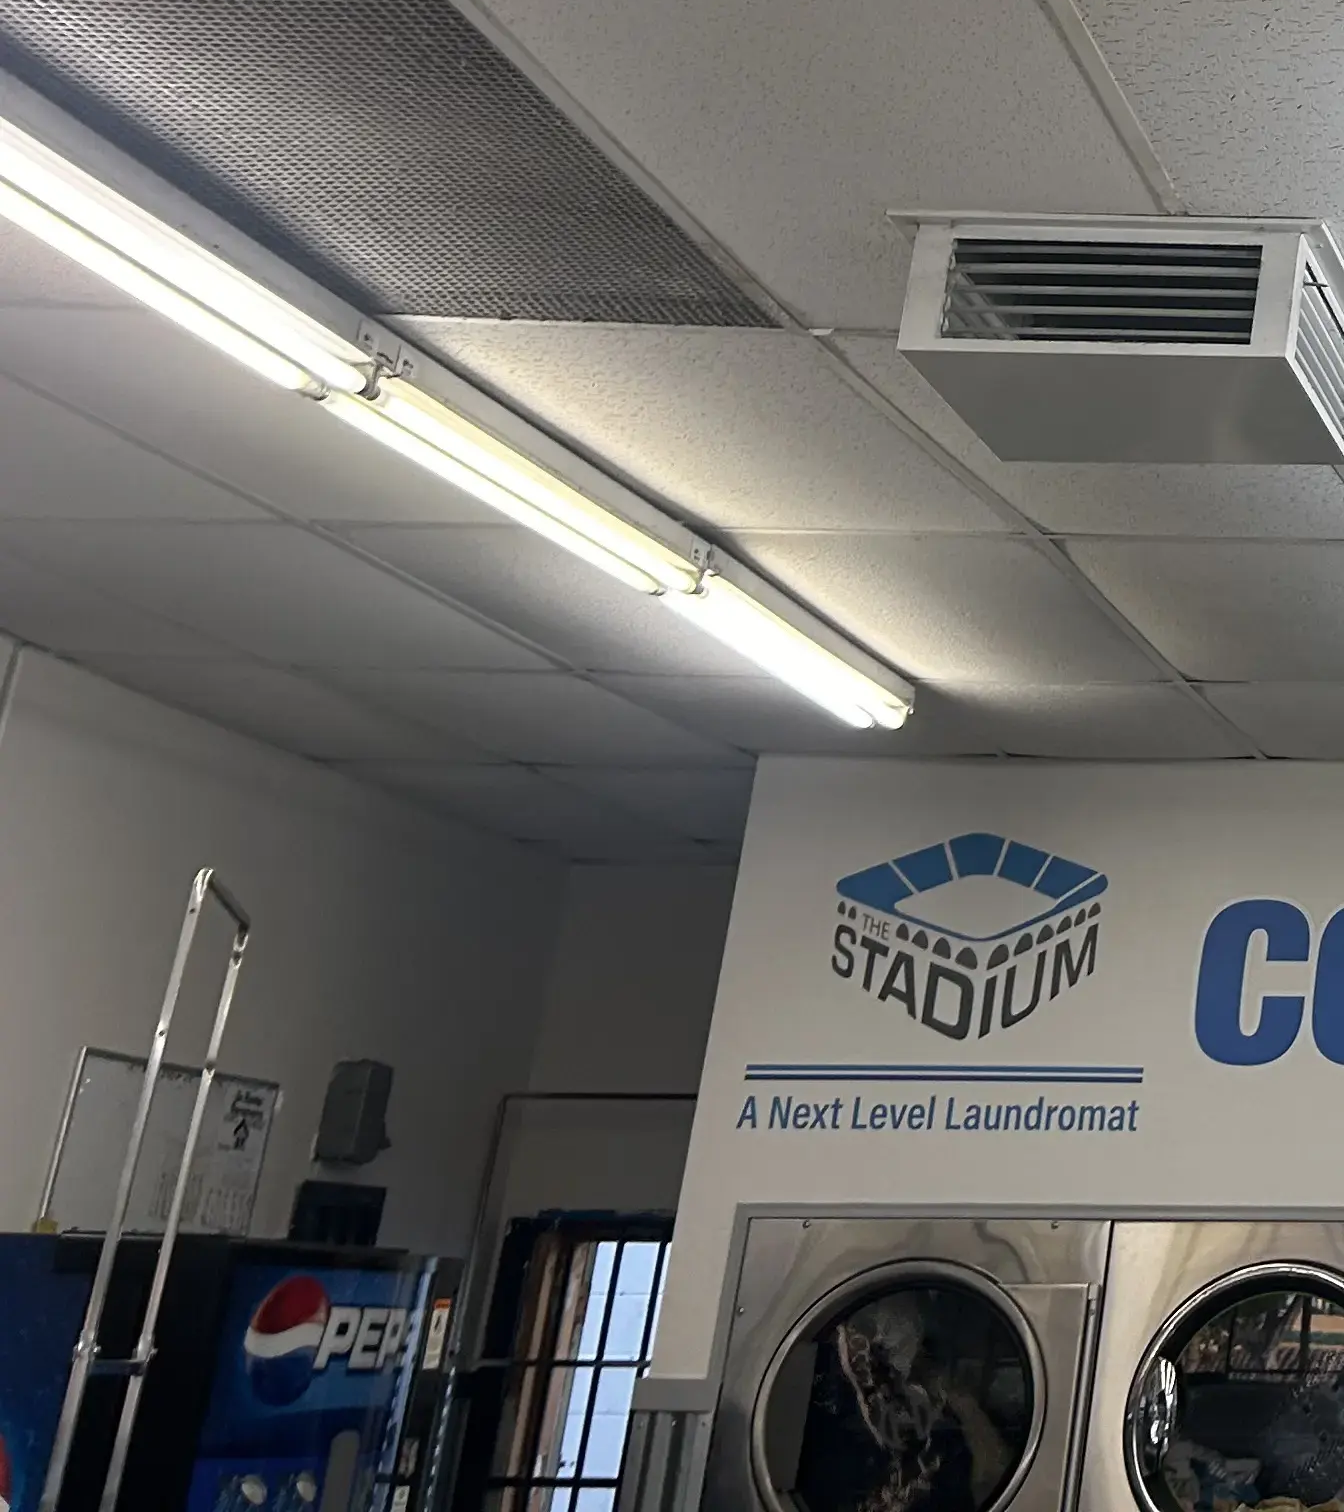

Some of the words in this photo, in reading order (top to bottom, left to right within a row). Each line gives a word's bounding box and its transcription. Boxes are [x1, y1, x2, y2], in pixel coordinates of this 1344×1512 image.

[862, 913, 890, 939] THE
[831, 923, 1099, 1041] STADIUM
[736, 1095, 757, 1130] A
[768, 1095, 844, 1130] Next
[851, 1094, 937, 1130] Level
[944, 1096, 1140, 1132] Laundromat
